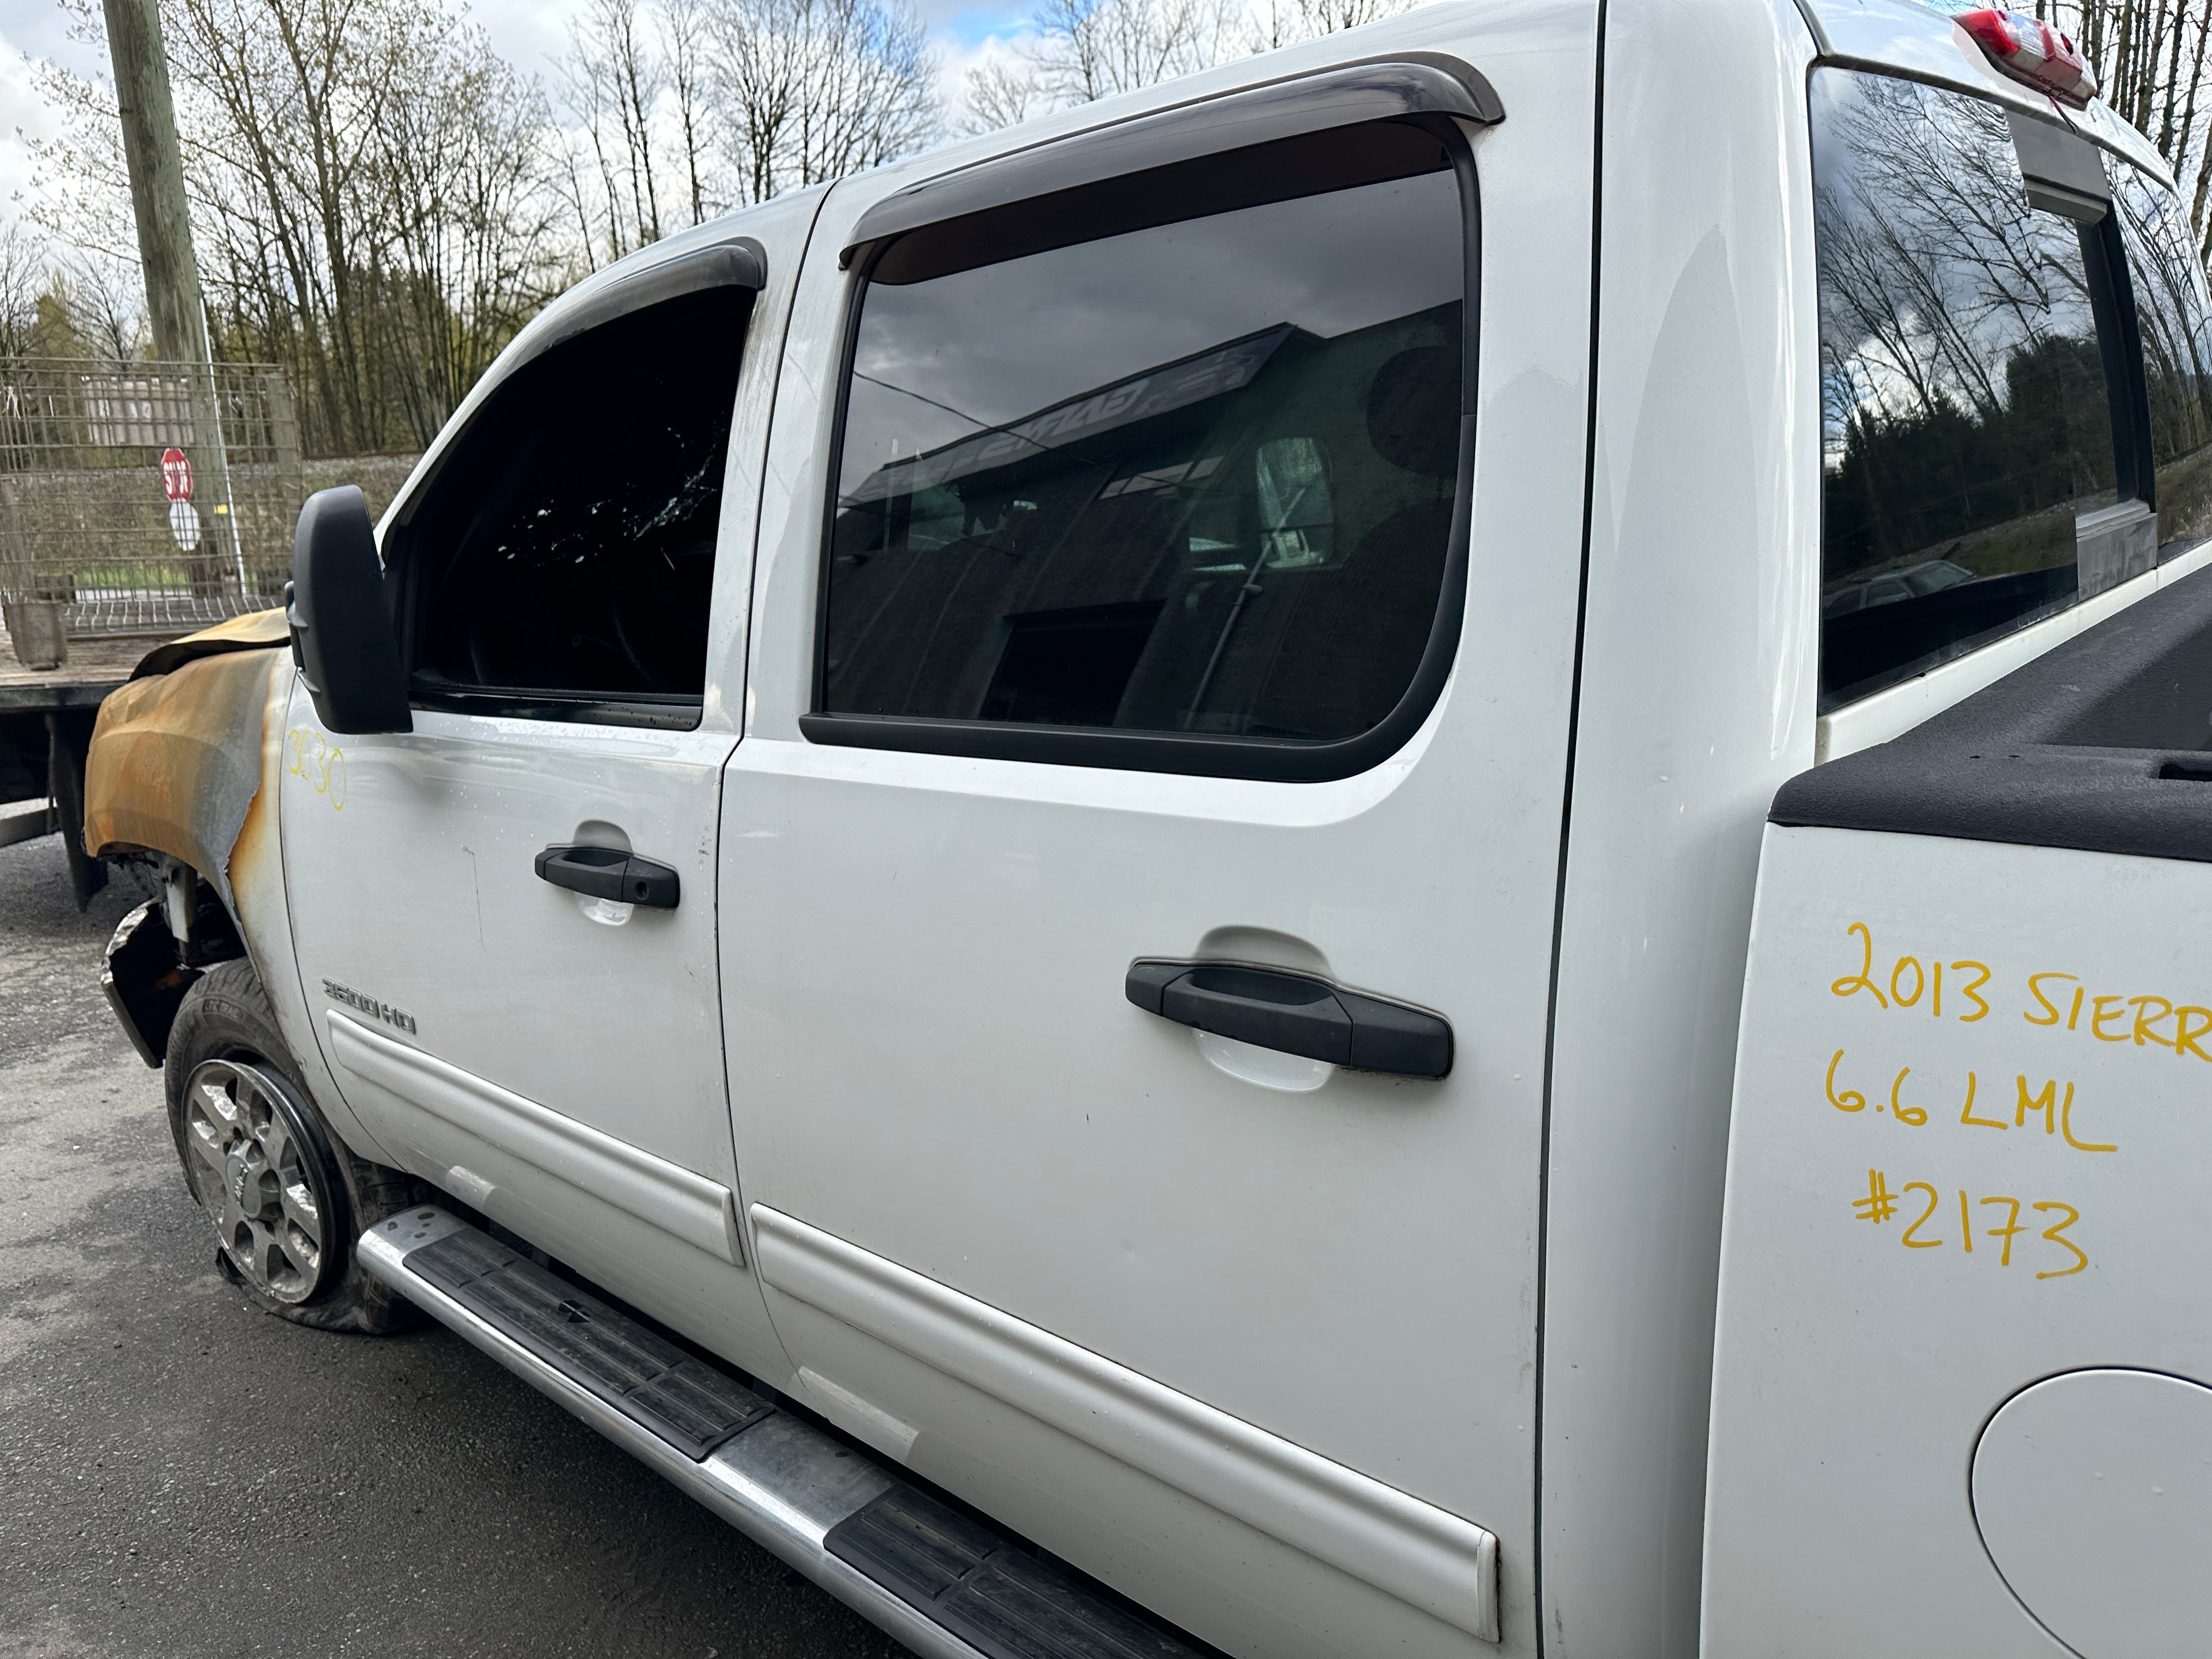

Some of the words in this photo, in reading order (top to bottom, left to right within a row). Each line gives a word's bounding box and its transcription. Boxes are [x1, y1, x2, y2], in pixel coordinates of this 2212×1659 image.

[321, 976, 380, 1018] 3500
[380, 1001, 416, 1035] HD
[1831, 922, 1991, 1022] 2013
[2022, 972, 2212, 1063] SIERR
[1825, 1048, 1927, 1126] 6.6
[1960, 1071, 2118, 1152] LML
[1851, 1168, 2088, 1279] #2173
